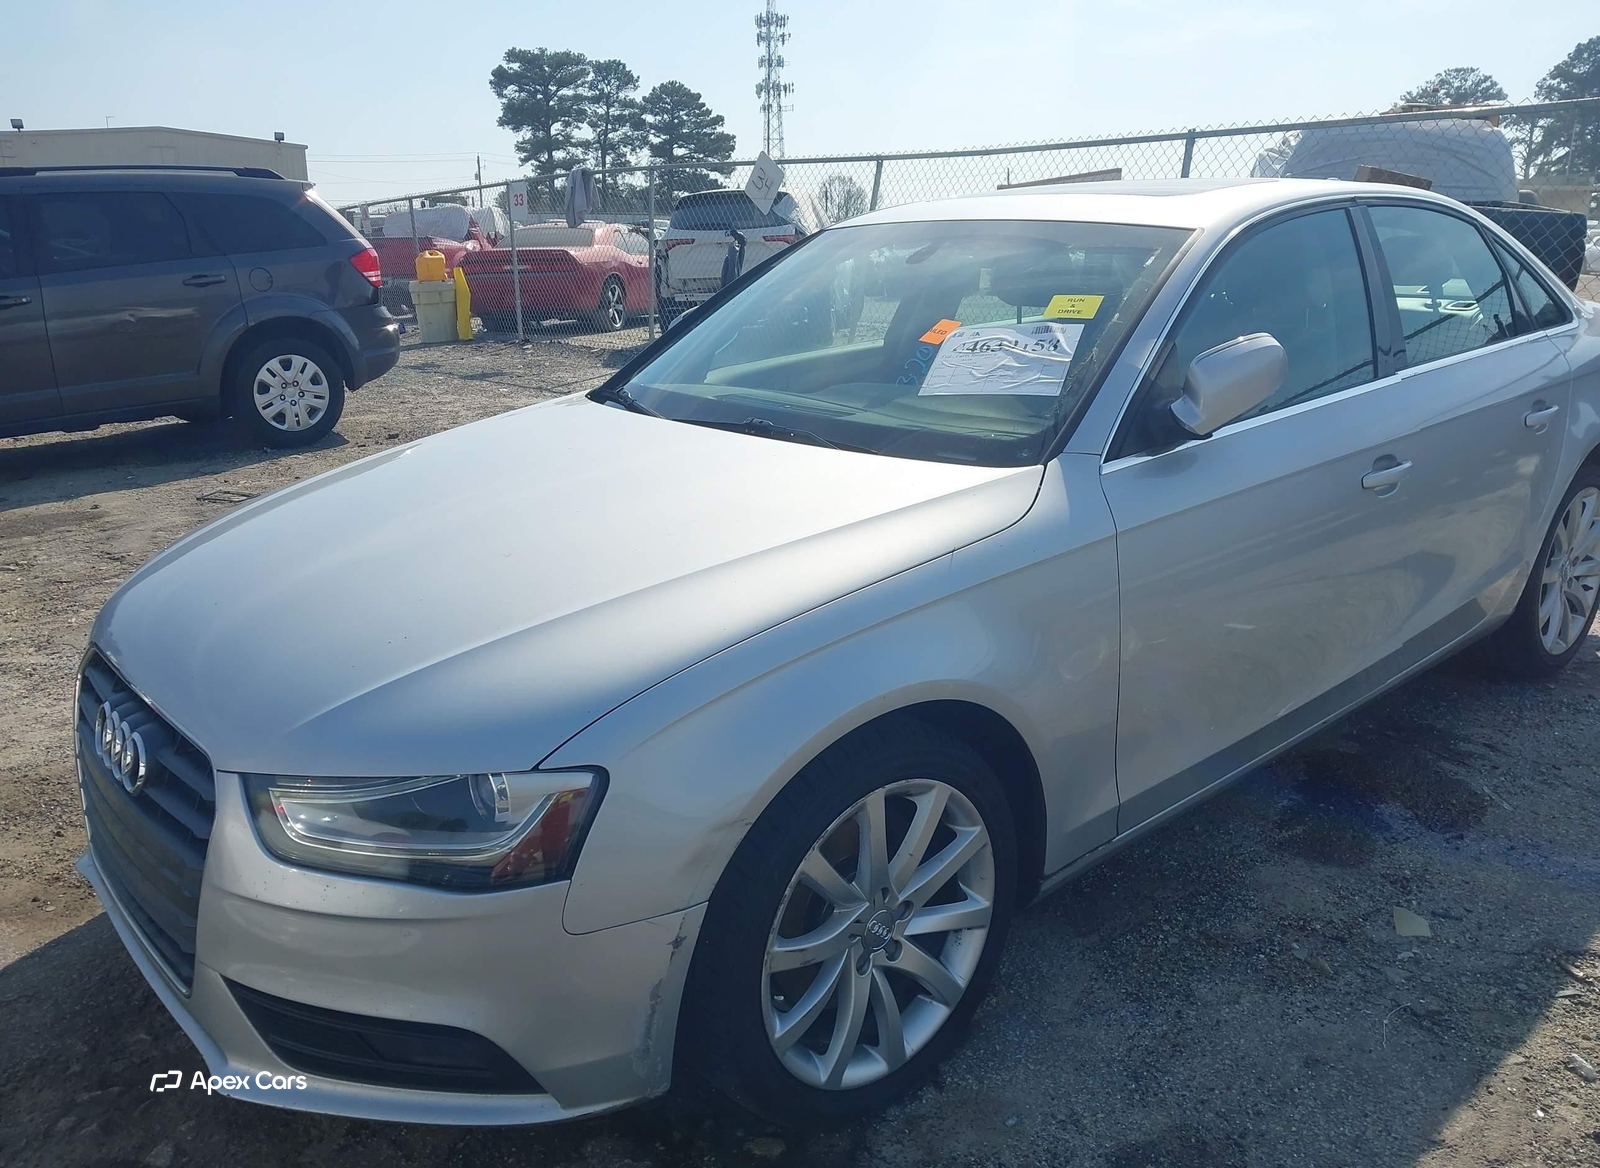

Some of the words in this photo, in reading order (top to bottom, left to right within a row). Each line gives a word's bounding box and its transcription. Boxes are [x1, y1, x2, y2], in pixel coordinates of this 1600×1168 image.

[513, 193, 524, 207] 33
[751, 166, 774, 200] 34
[895, 346, 934, 388] 320
